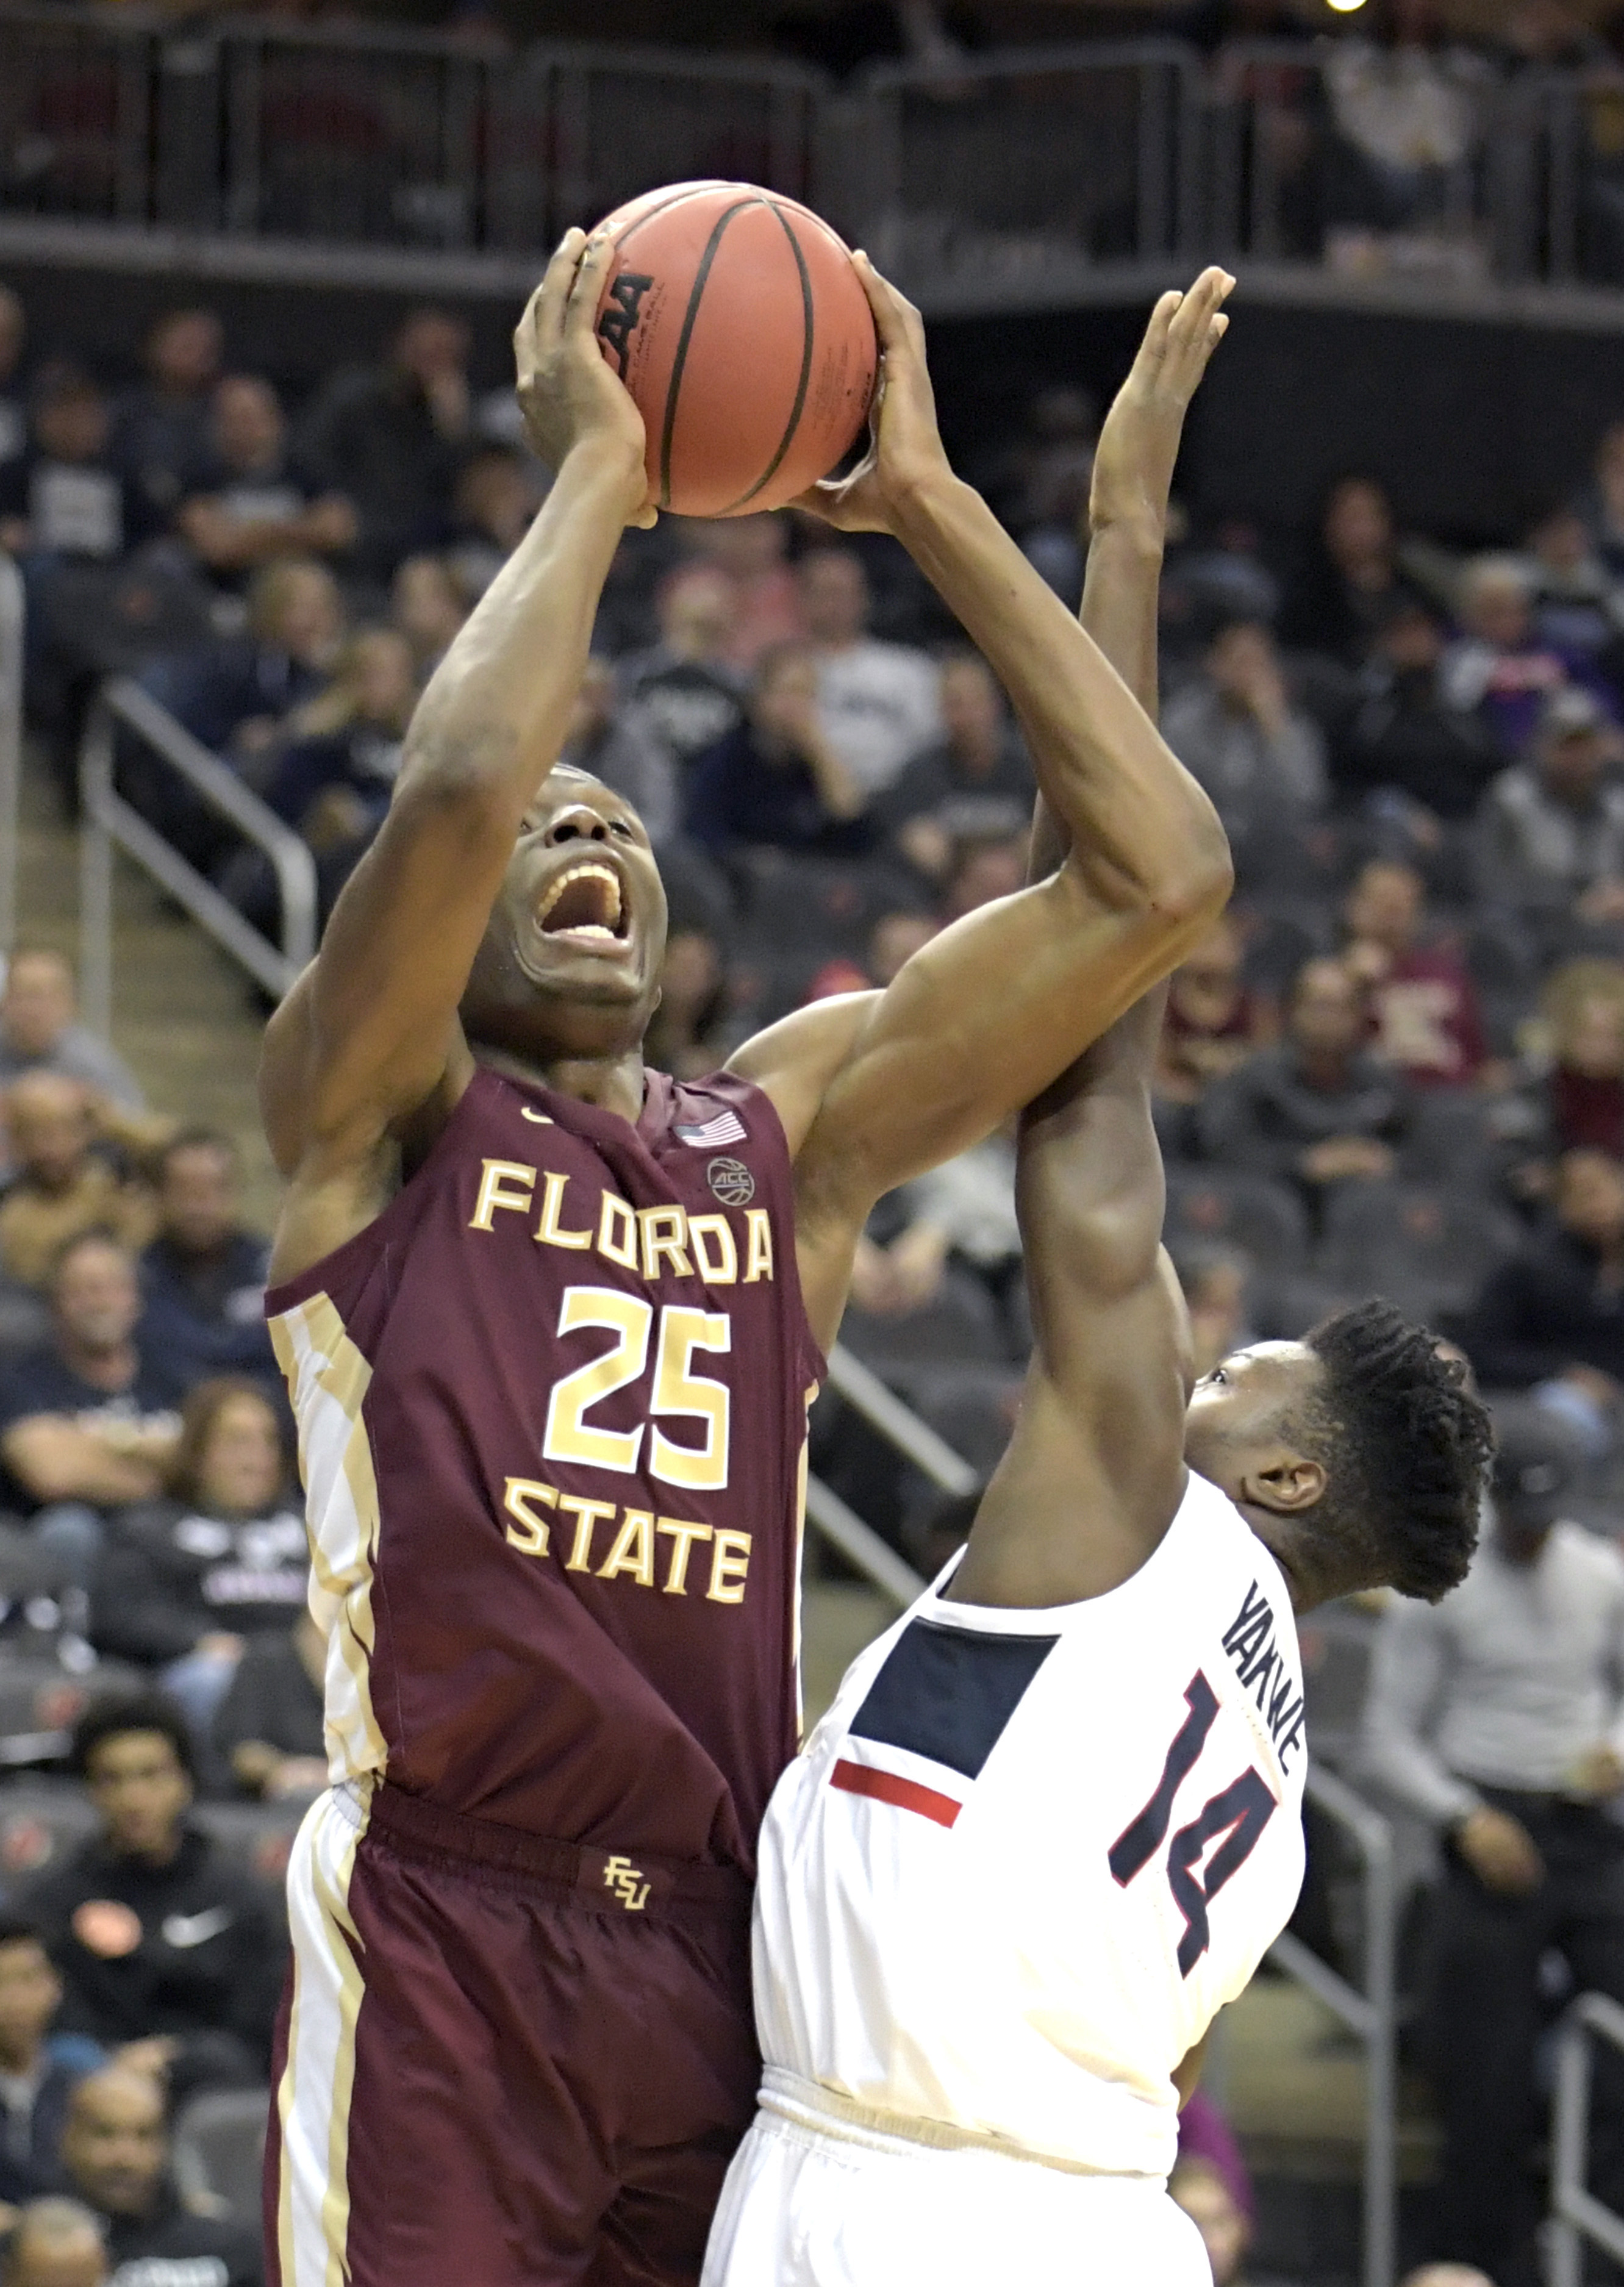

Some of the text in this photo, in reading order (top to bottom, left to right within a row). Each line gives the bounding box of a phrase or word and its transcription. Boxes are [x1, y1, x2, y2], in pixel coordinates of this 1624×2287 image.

[468, 1159, 773, 1284] FLORDA
[715, 1172, 749, 1184] ACC
[542, 1286, 731, 1491] 25
[504, 1476, 753, 1604] STATE
[1222, 1578, 1305, 1777] YAKWE
[603, 1856, 651, 1909] FSU
[1107, 1667, 1278, 1980] 14
